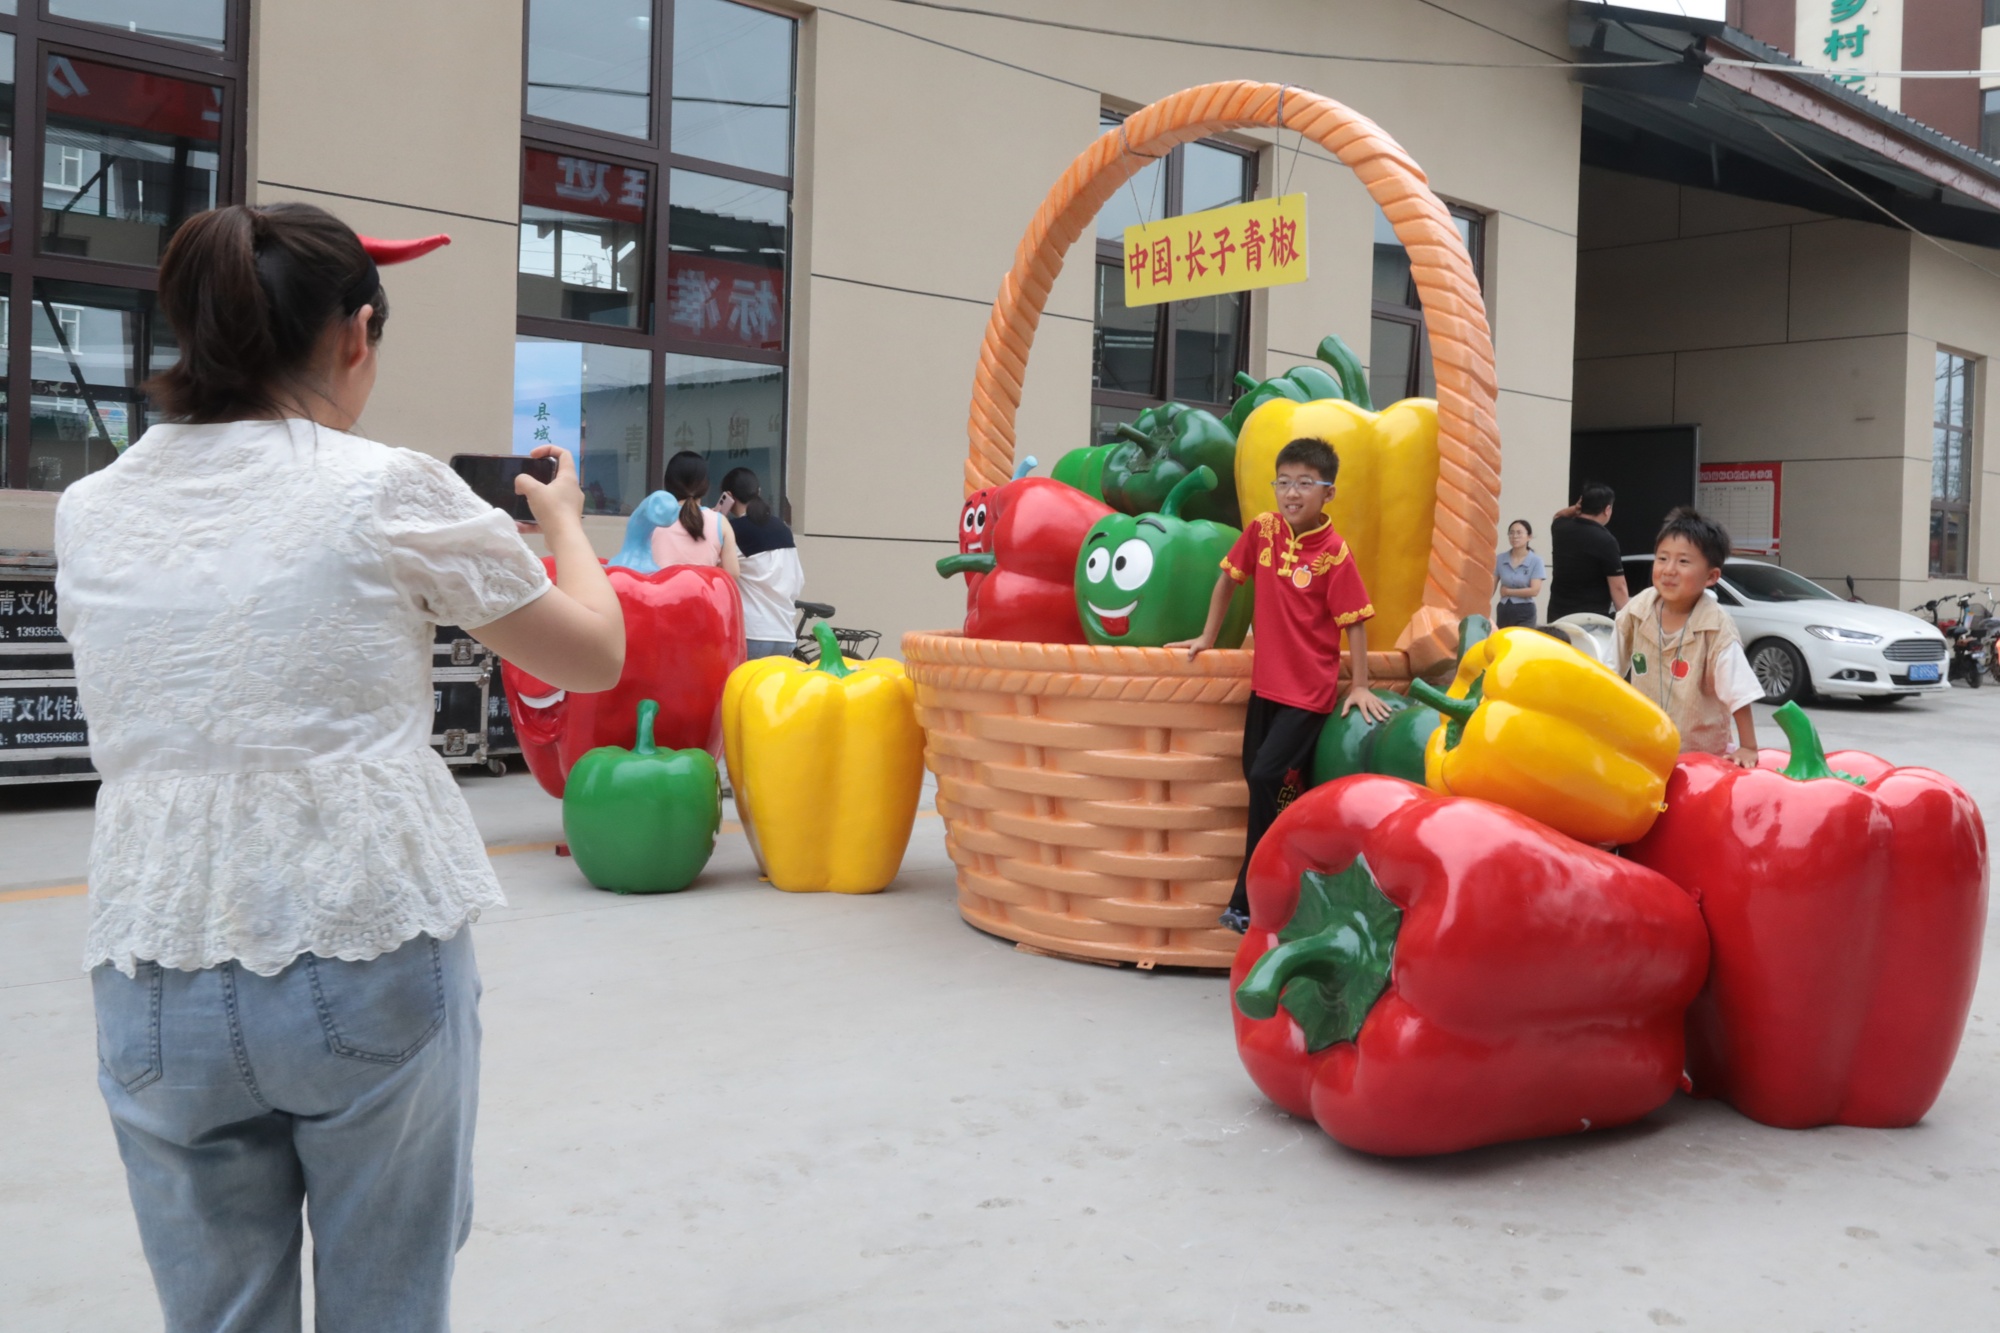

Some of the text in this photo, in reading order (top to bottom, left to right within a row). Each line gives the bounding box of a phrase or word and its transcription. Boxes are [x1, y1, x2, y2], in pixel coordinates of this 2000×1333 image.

[1823, 0, 1870, 92] 乡村
[1128, 215, 1300, 290] 中国·长子青椒
[533, 402, 552, 443] 县域
[0, 590, 57, 616] 青文化
[16, 626, 62, 637] 1393555
